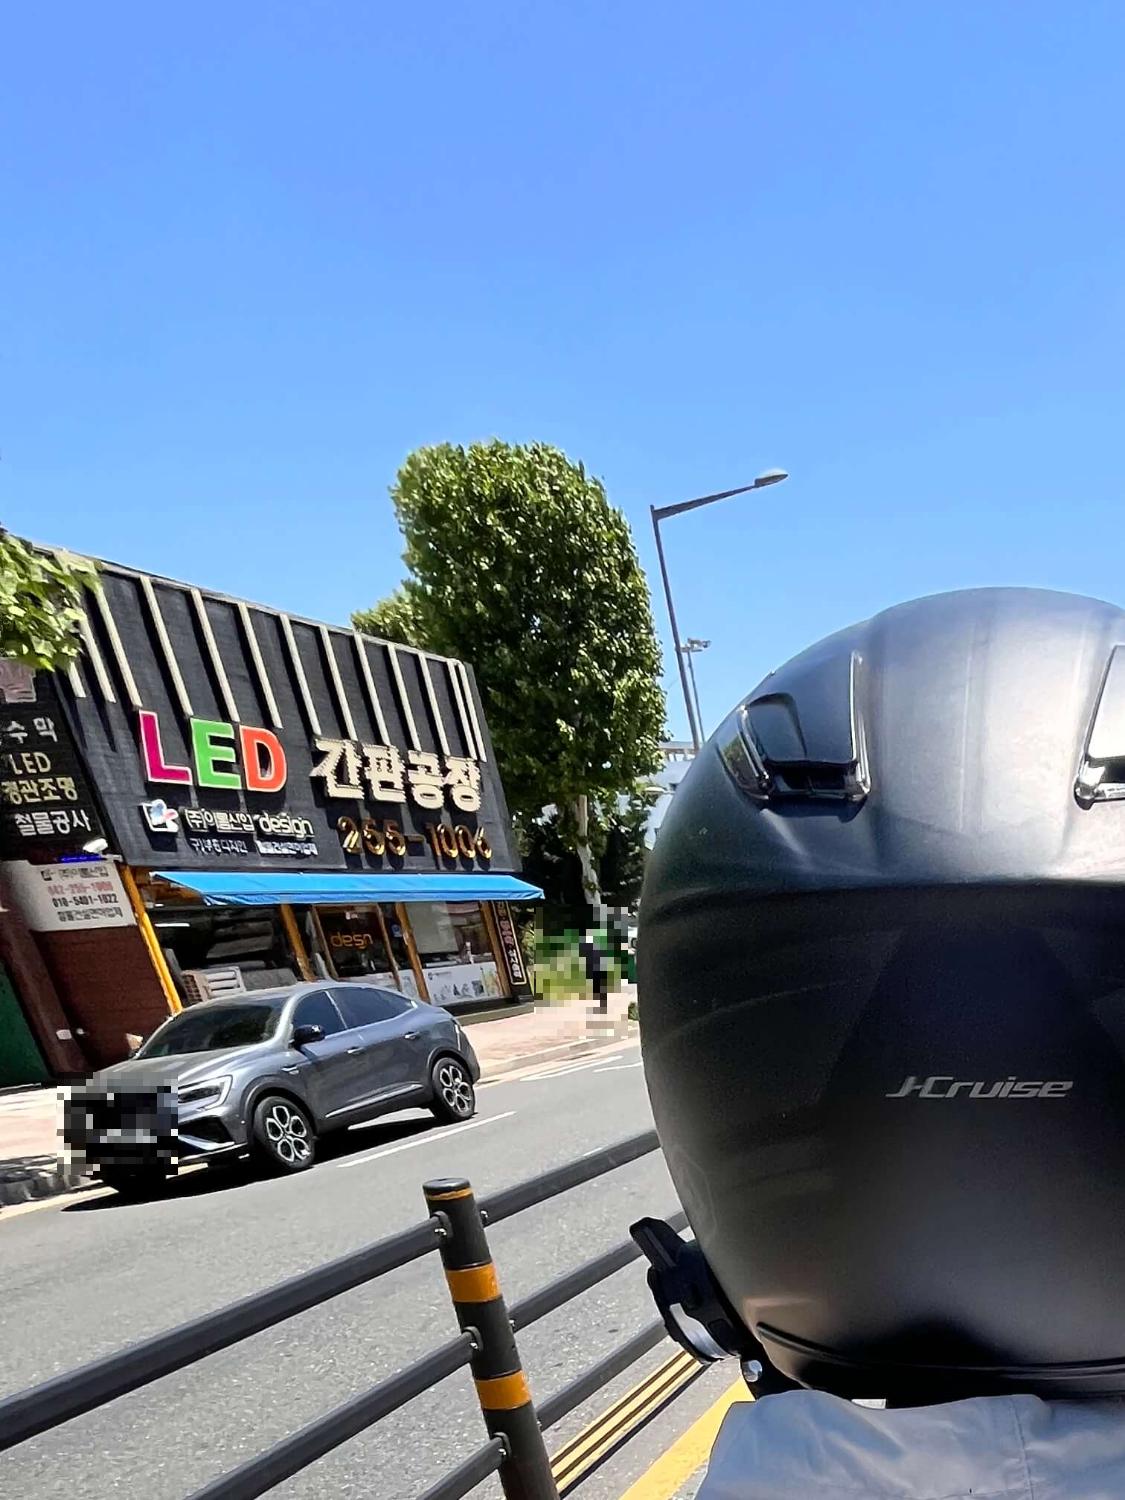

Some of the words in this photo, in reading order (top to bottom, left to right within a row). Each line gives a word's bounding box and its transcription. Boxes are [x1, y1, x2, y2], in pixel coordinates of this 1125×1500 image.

[0, 717, 58, 743] 수막
[9, 751, 52, 775] LED
[139, 709, 287, 793] LED
[309, 736, 482, 812] 간판공장
[1, 777, 78, 805] 경관조명
[15, 809, 92, 836] 철물공사
[259, 811, 315, 839] design
[337, 816, 493, 859] 255-1006
